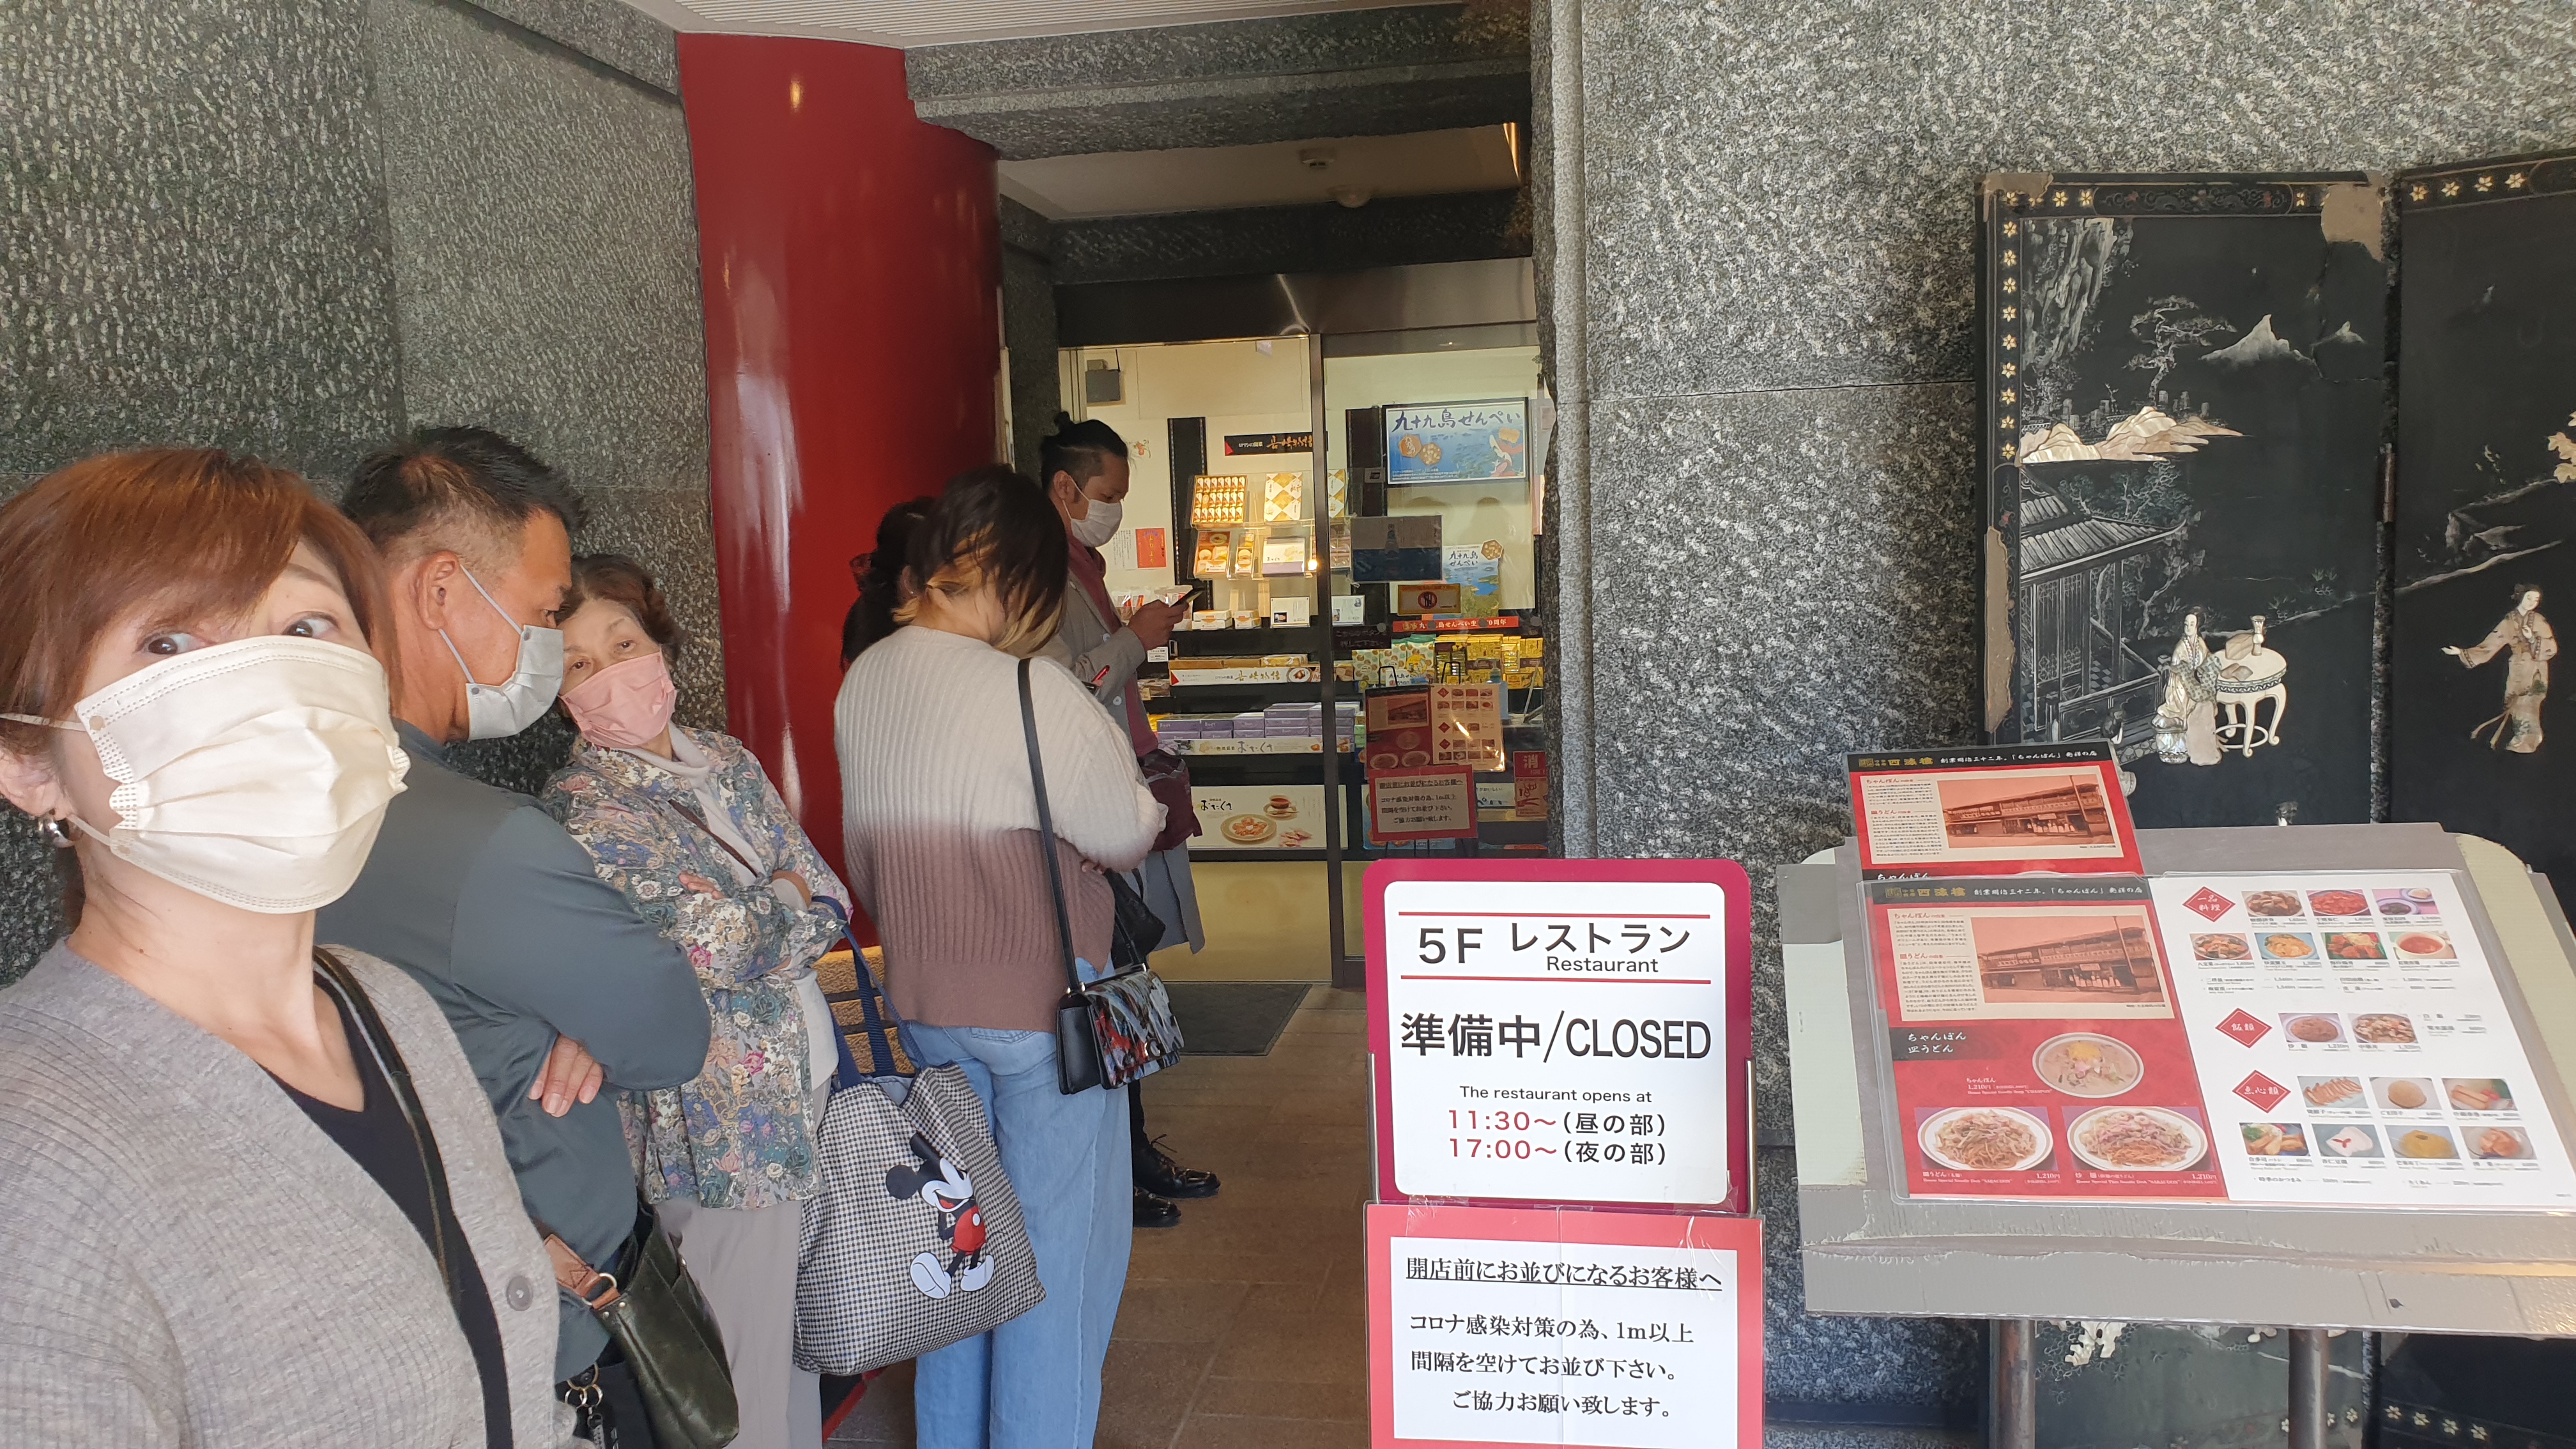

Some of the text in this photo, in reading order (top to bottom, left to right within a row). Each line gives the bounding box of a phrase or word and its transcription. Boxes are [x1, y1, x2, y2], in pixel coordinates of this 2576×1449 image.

[1392, 408, 1521, 433] 九十九島せんぺい
[1449, 550, 1478, 560] 九十九島
[1200, 800, 1232, 811] おたくさ
[1418, 927, 1483, 964] 5F
[1511, 923, 1690, 954] レストラン
[1546, 956, 1659, 973] Restaurant
[1401, 1010, 1712, 1064] 準備中/CLOSED
[1908, 1032, 1966, 1042] ちゃんぽん
[1908, 1044, 1953, 1054] 皿うどん
[1460, 1086, 1652, 1104] The restaurant opens at
[1407, 1257, 1722, 1289] 開店前にお並びになるお客様へ
[1409, 1314, 1694, 1344] コロナ感染対策の為、1m以上
[1411, 1350, 1675, 1381] 間隔を空けてお並び下さい。
[1453, 1390, 1669, 1418] ご協力お願い致します。
